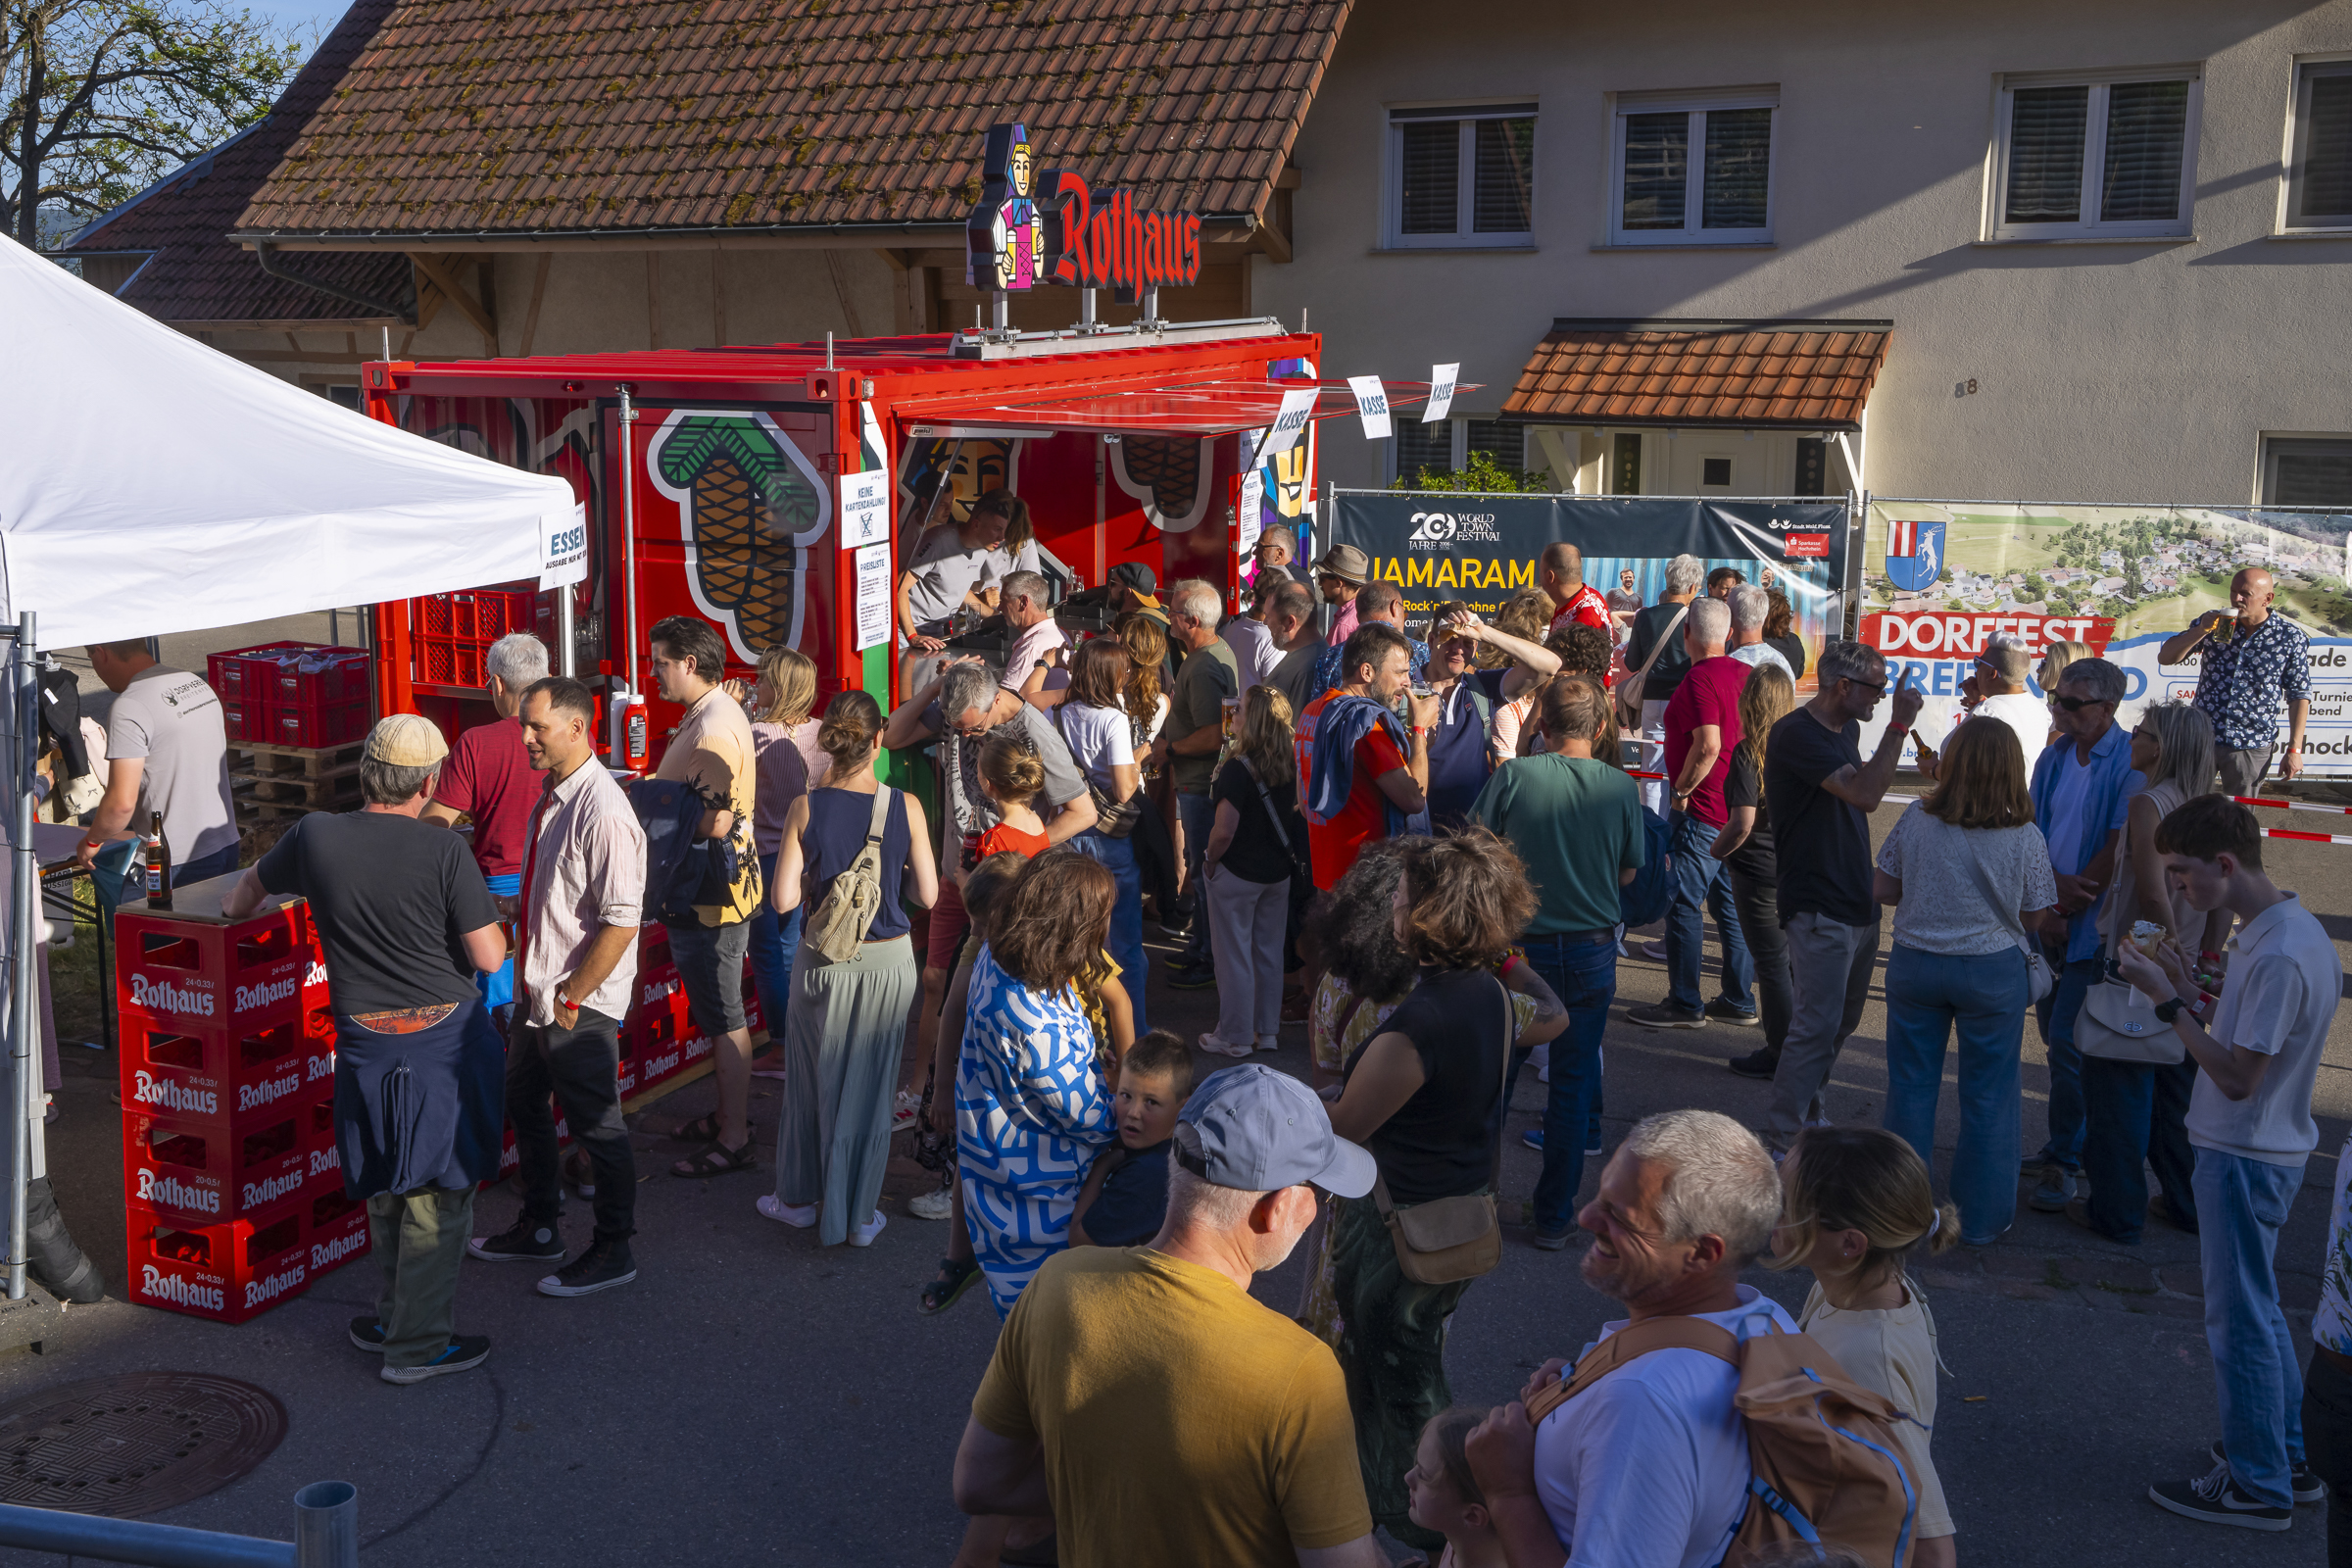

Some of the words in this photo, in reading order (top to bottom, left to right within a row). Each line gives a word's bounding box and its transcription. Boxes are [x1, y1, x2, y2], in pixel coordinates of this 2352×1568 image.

[1055, 169, 1202, 306] Rothaus
[1431, 382, 1454, 403] KASSE
[1967, 378, 1978, 394] 8
[1360, 395, 1387, 416] KASSE
[1274, 409, 1309, 433] KASSE
[858, 486, 873, 499] KEINE
[1457, 513, 1494, 523] WORLD
[1461, 522, 1494, 532] TOWN
[551, 523, 585, 557] ESSEN
[1408, 541, 1437, 552] JAHRE
[1456, 531, 1502, 541] FESTIVAL
[545, 557, 567, 570] AUSGABE
[860, 559, 885, 572] PREISLISTE
[2308, 705, 2342, 715] bend
[2313, 690, 2352, 702] Turnie
[129, 973, 214, 1016] Rothaus
[234, 978, 296, 1012] Rothaus
[643, 978, 678, 1005] Rothaus
[306, 1050, 337, 1082] Roth
[645, 1052, 679, 1081] Rothaus
[134, 1070, 218, 1115] Rothaus
[238, 1073, 300, 1112] Rothaus
[309, 1145, 341, 1177] Roth
[136, 1168, 220, 1214] Rothaus
[242, 1169, 303, 1210] Rothaus
[311, 1229, 367, 1270] Rothaus
[141, 1264, 224, 1311] Rothaus
[244, 1264, 306, 1309] Rothaus
